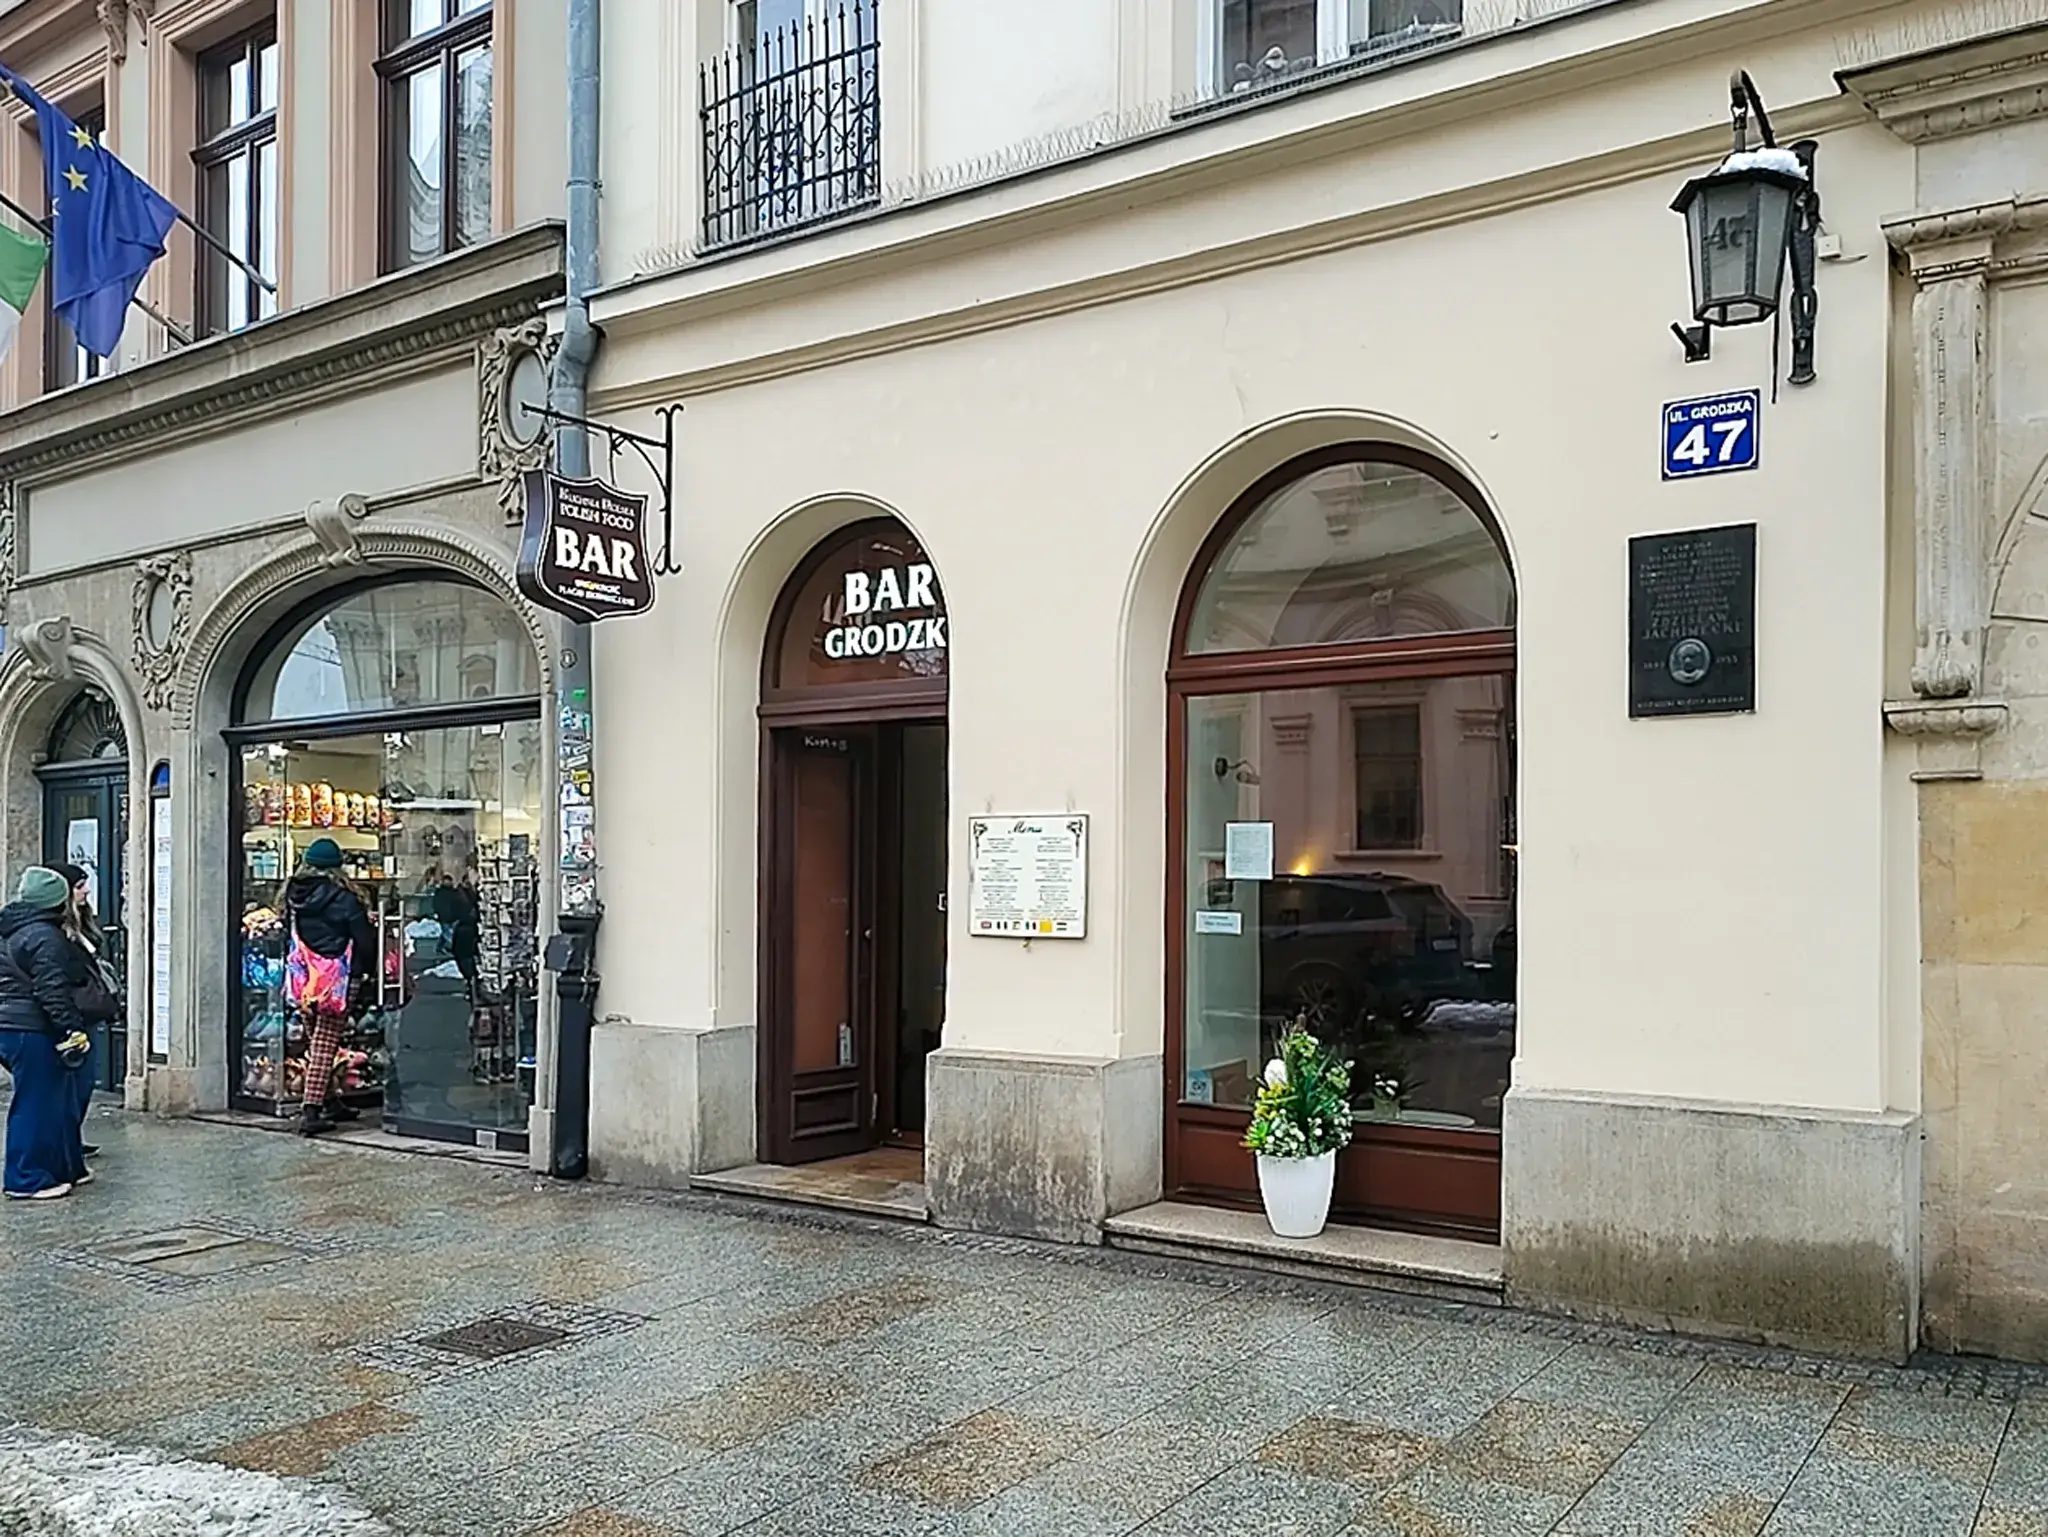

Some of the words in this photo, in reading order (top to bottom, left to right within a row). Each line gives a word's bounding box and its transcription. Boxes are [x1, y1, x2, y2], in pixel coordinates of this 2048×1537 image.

[1670, 410, 1689, 423] UL.
[1690, 400, 1752, 419] GRODZKA
[1672, 418, 1748, 465] 47
[559, 502, 600, 523] POLISH
[602, 512, 635, 531] FOOD
[553, 526, 639, 582] BAR
[844, 563, 936, 617] BAR
